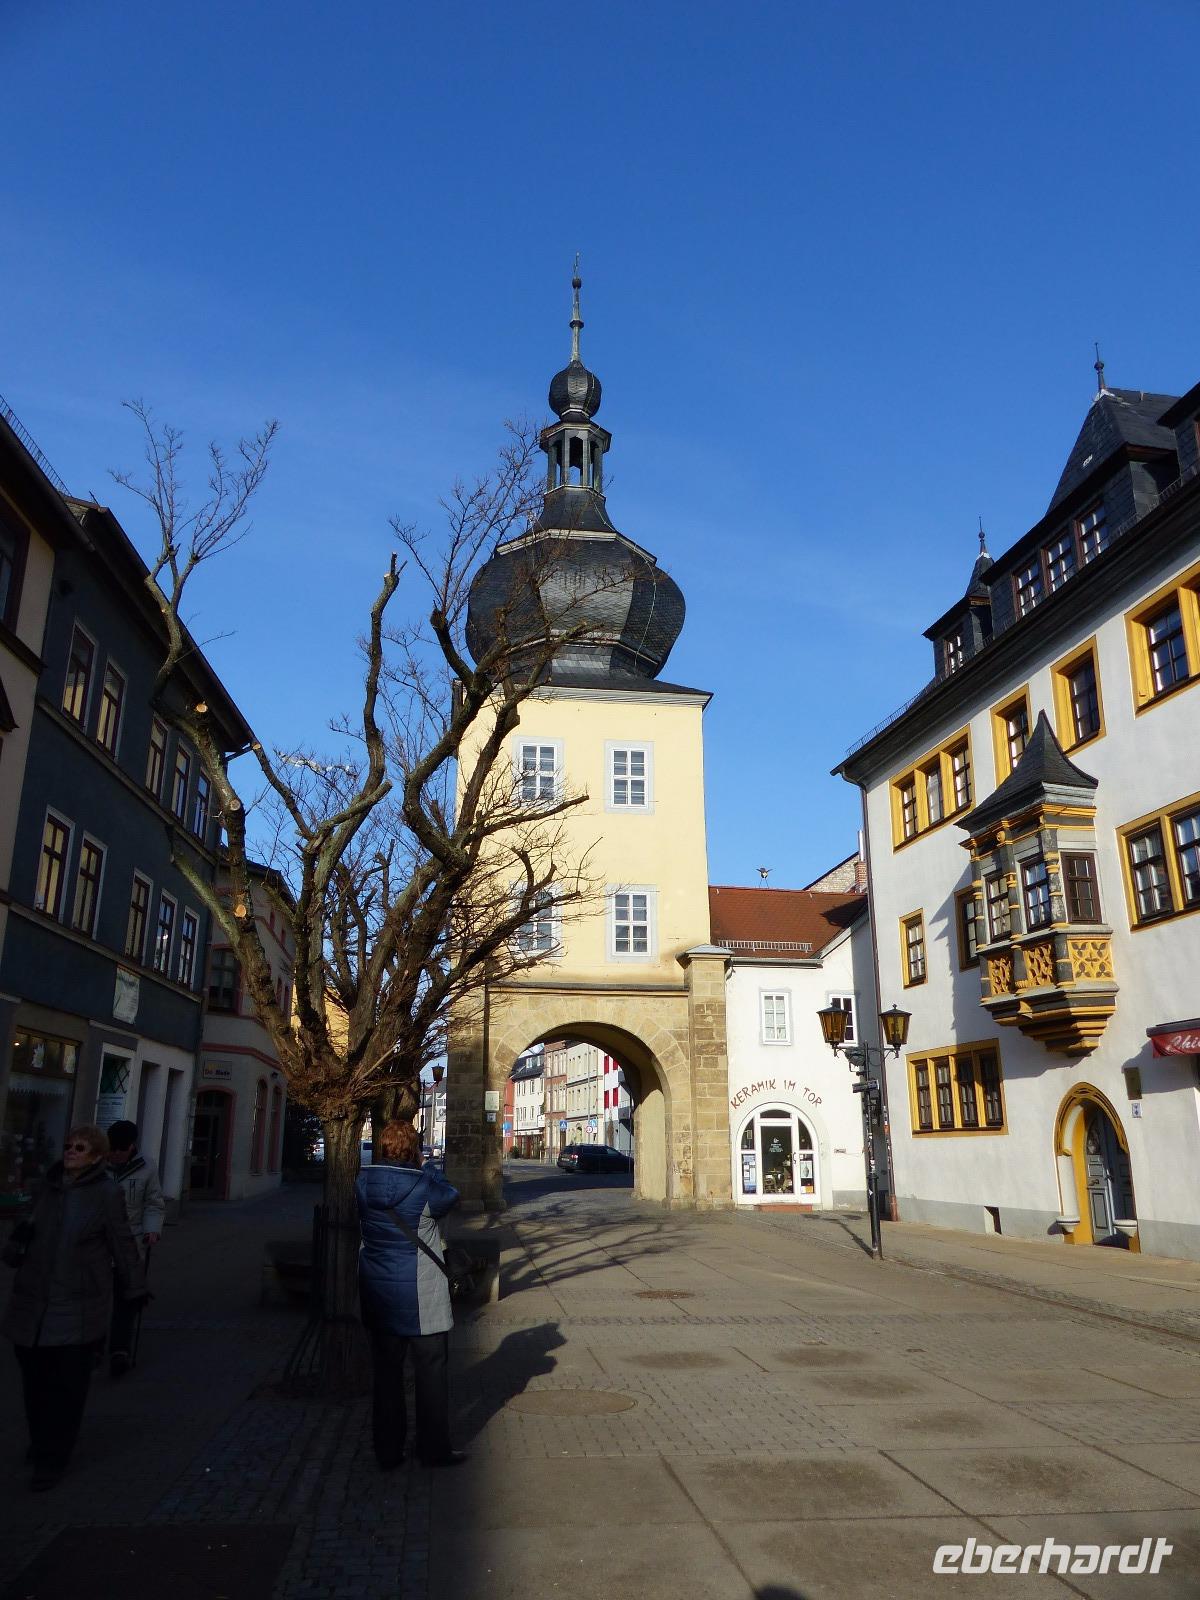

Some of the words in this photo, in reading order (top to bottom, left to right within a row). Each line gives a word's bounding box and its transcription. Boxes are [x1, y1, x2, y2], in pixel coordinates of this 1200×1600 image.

[730, 1078, 776, 1109] KERAMIK
[783, 1079, 796, 1092] IM
[802, 1086, 823, 1108] TOR
